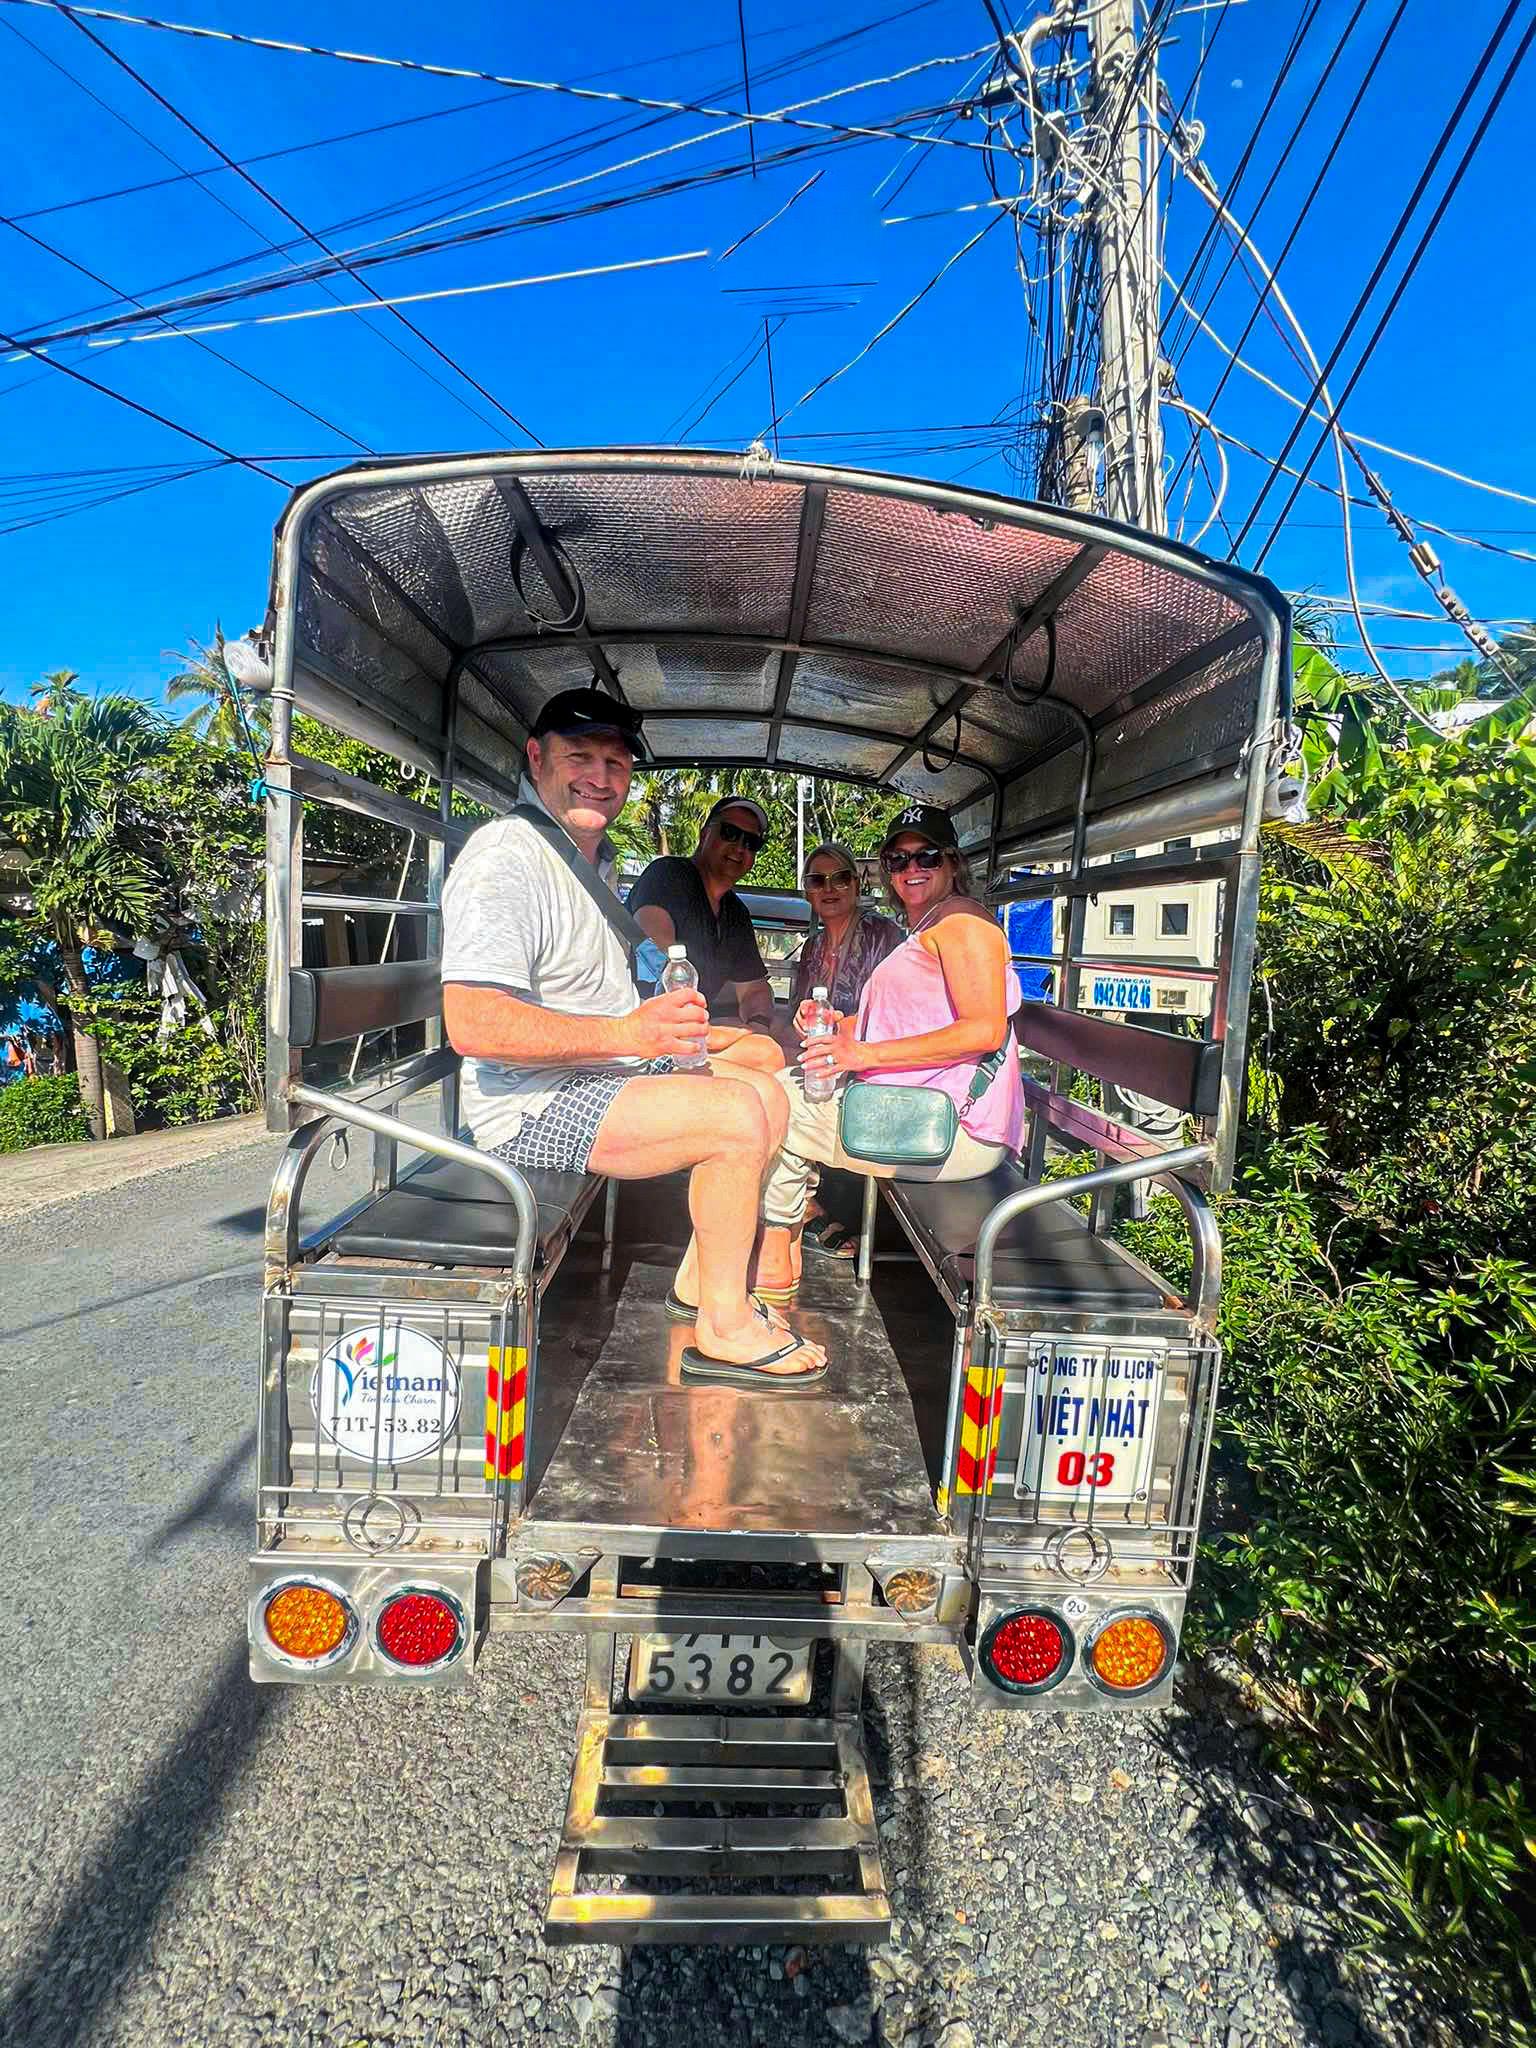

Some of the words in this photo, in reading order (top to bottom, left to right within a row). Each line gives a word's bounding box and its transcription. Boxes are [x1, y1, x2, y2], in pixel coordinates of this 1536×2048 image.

[1083, 1358, 1098, 1378] TY
[1124, 1360, 1155, 1384] LỊCH
[1088, 1390, 1150, 1448] NHẬT
[1056, 1451, 1116, 1488] 03
[648, 1650, 794, 1696] 5382
